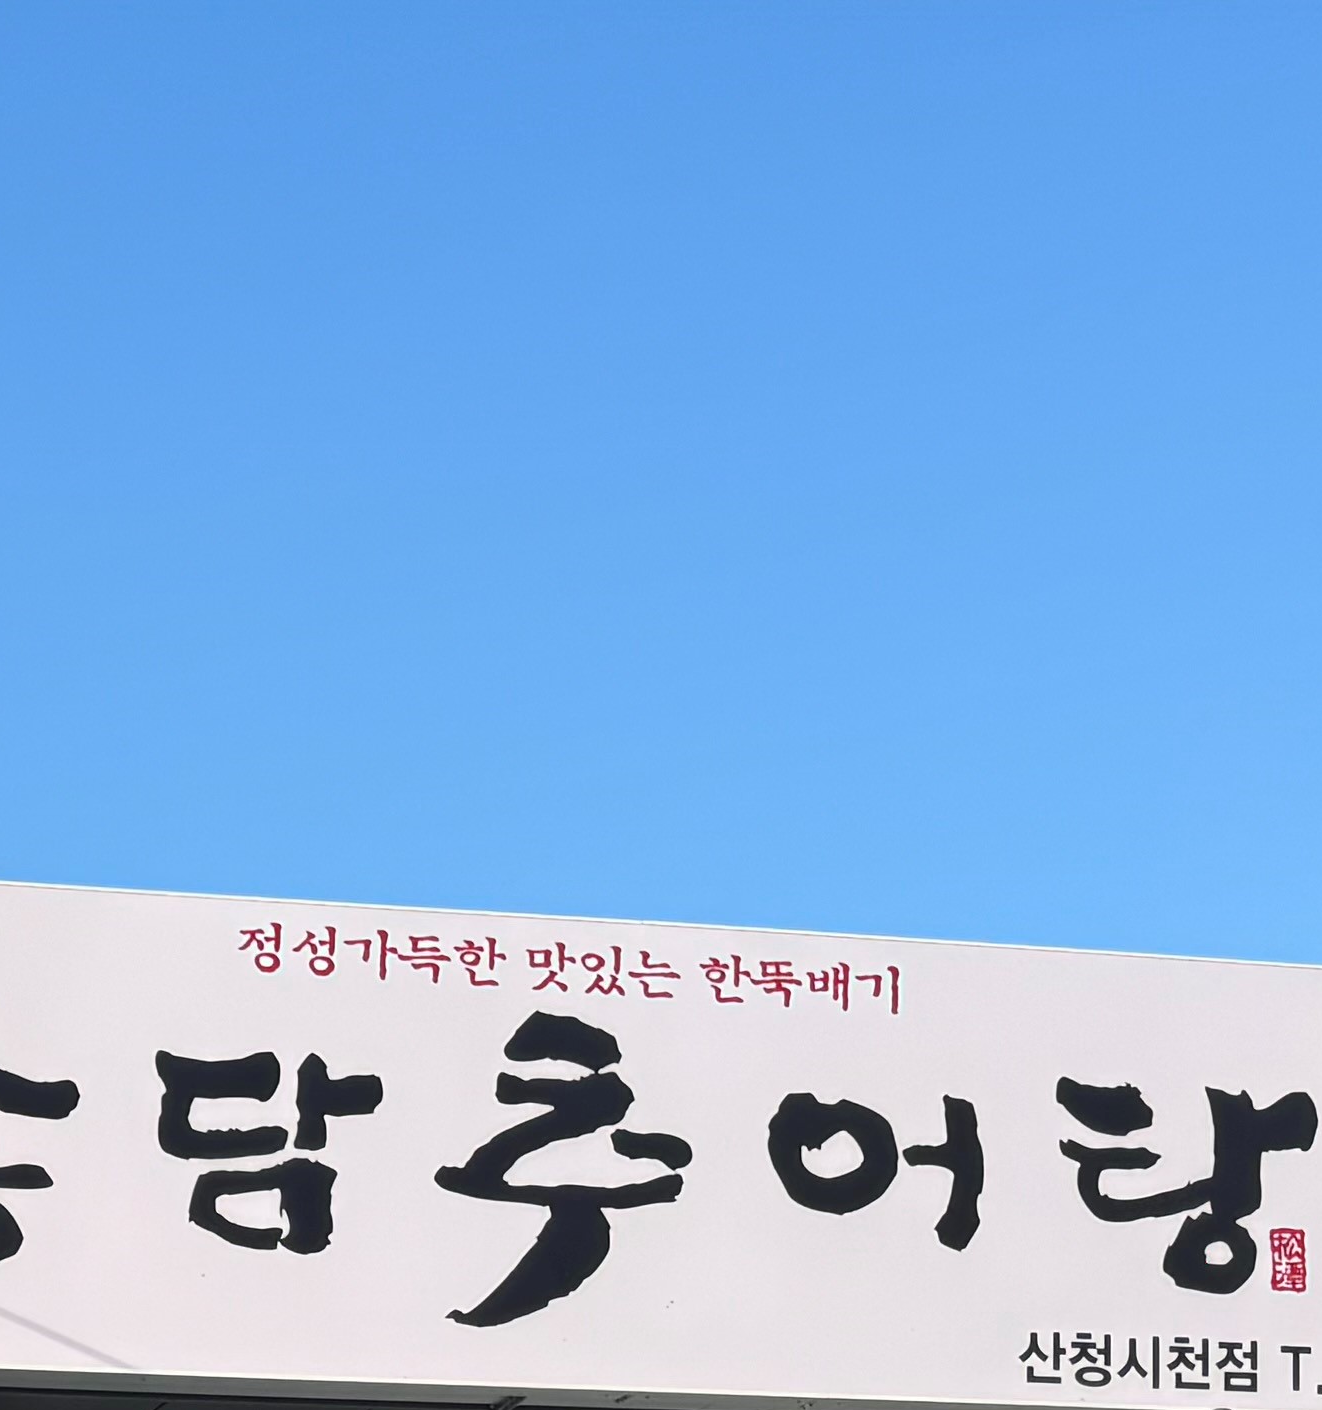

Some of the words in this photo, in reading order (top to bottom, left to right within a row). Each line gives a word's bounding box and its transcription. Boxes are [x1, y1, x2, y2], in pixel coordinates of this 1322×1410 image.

[239, 923, 507, 987] 정성가득한
[526, 942, 681, 998] 맛있는
[699, 955, 900, 1014] 한뚝배기
[1019, 1332, 1259, 1393] 산청시천점
